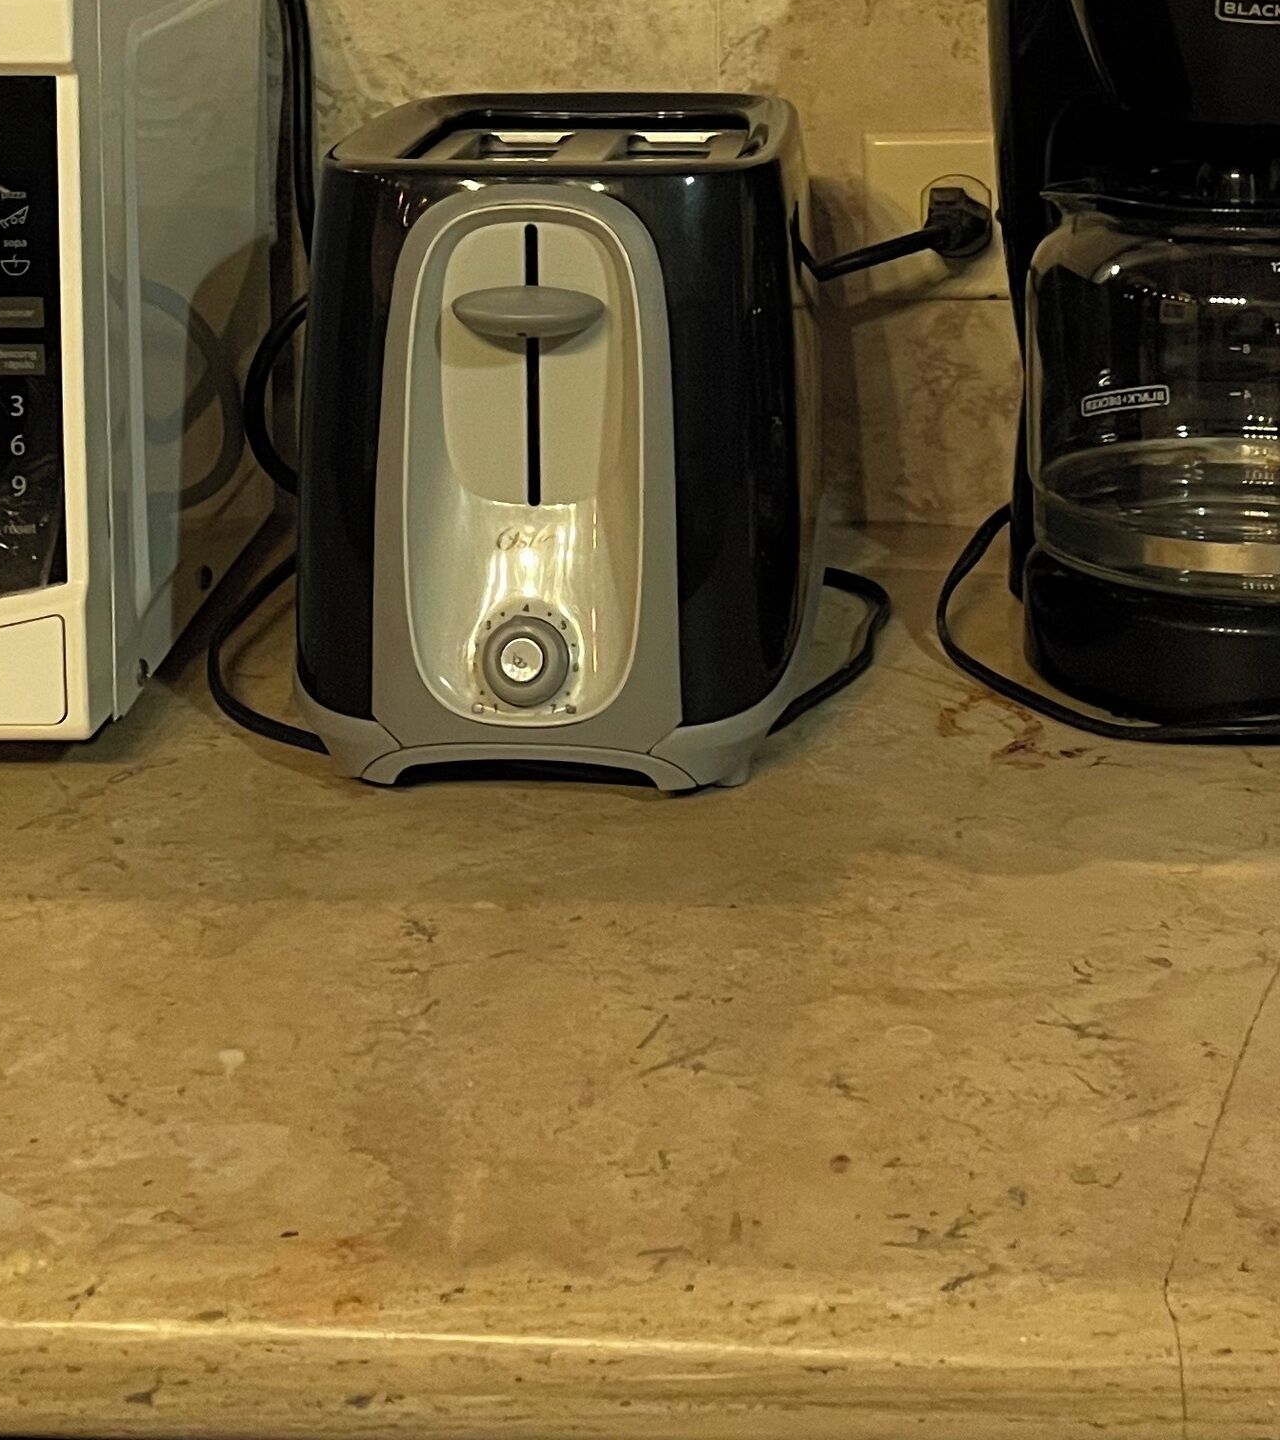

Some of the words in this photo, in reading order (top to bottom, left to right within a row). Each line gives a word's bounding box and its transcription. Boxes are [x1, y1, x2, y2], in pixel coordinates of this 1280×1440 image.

[10, 395, 24, 416] 3
[10, 434, 25, 455] 6
[11, 475, 27, 496] 9
